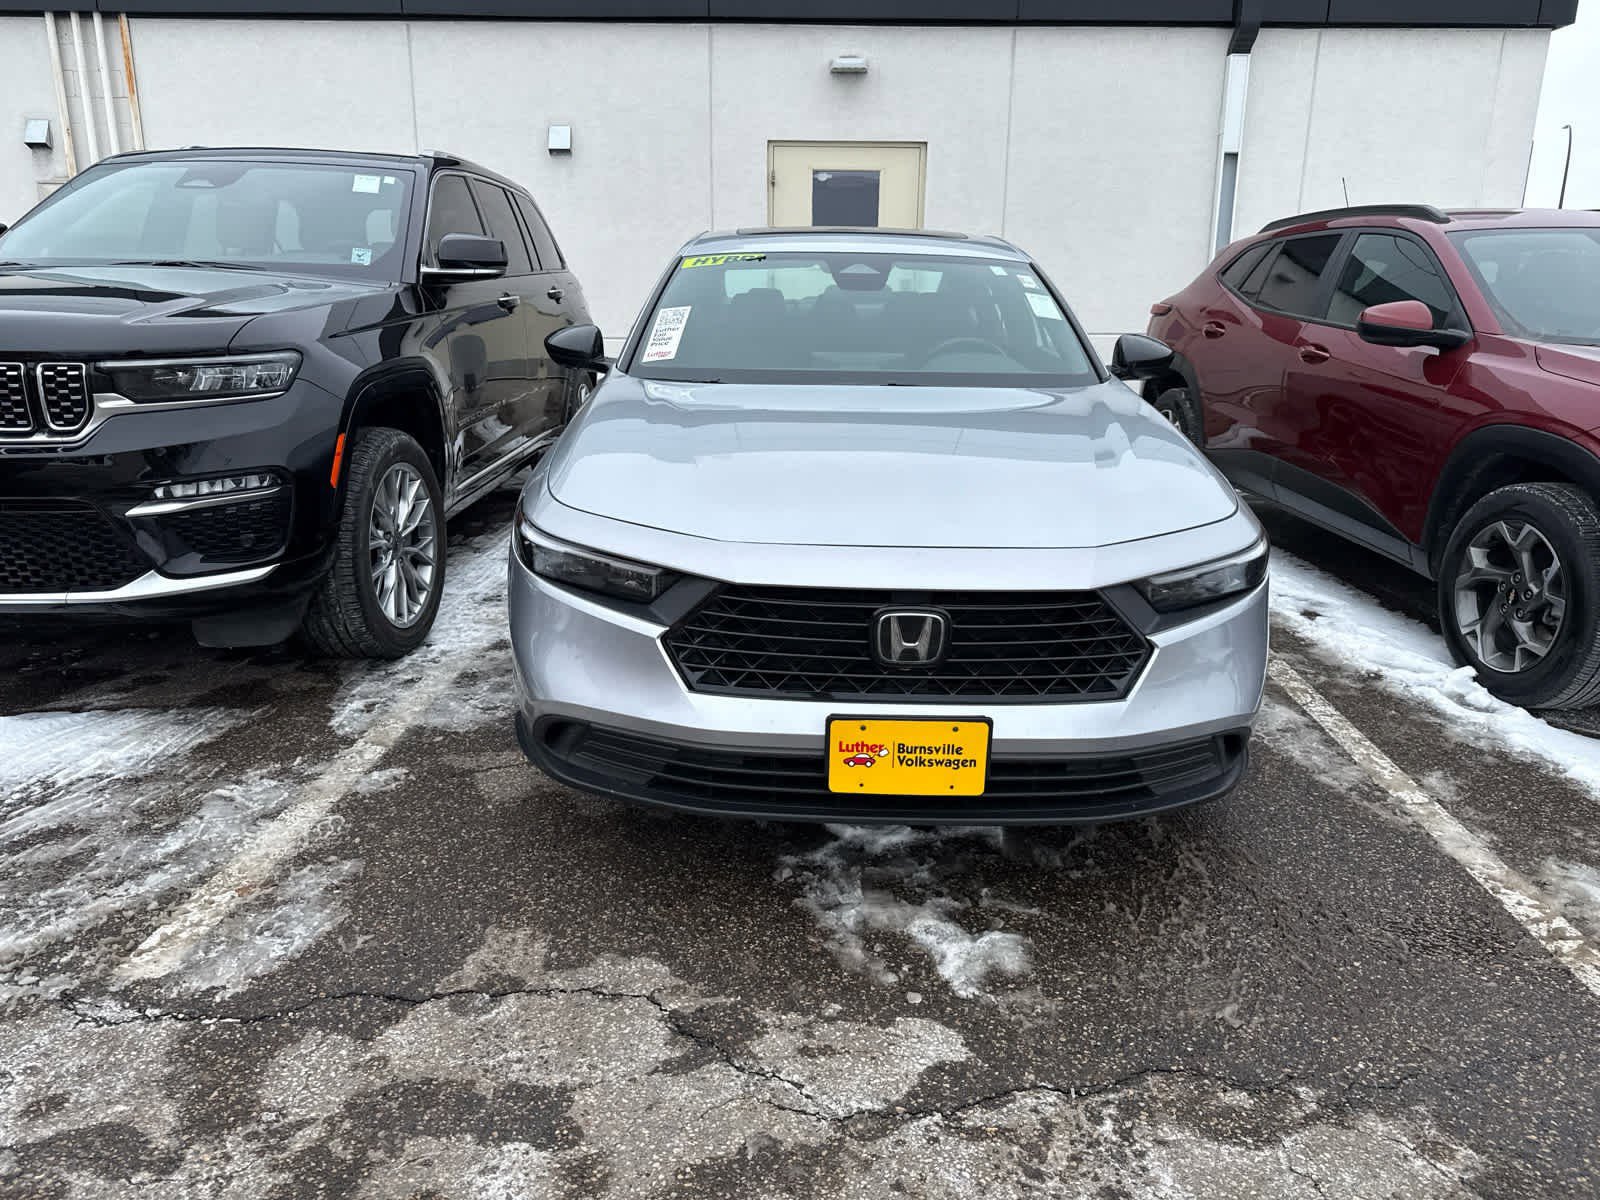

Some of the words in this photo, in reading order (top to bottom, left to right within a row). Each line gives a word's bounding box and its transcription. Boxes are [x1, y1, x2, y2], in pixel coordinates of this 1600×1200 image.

[838, 741, 884, 753] Luther
[897, 743, 964, 755] Burnsville
[897, 755, 977, 770] Volkswagen
